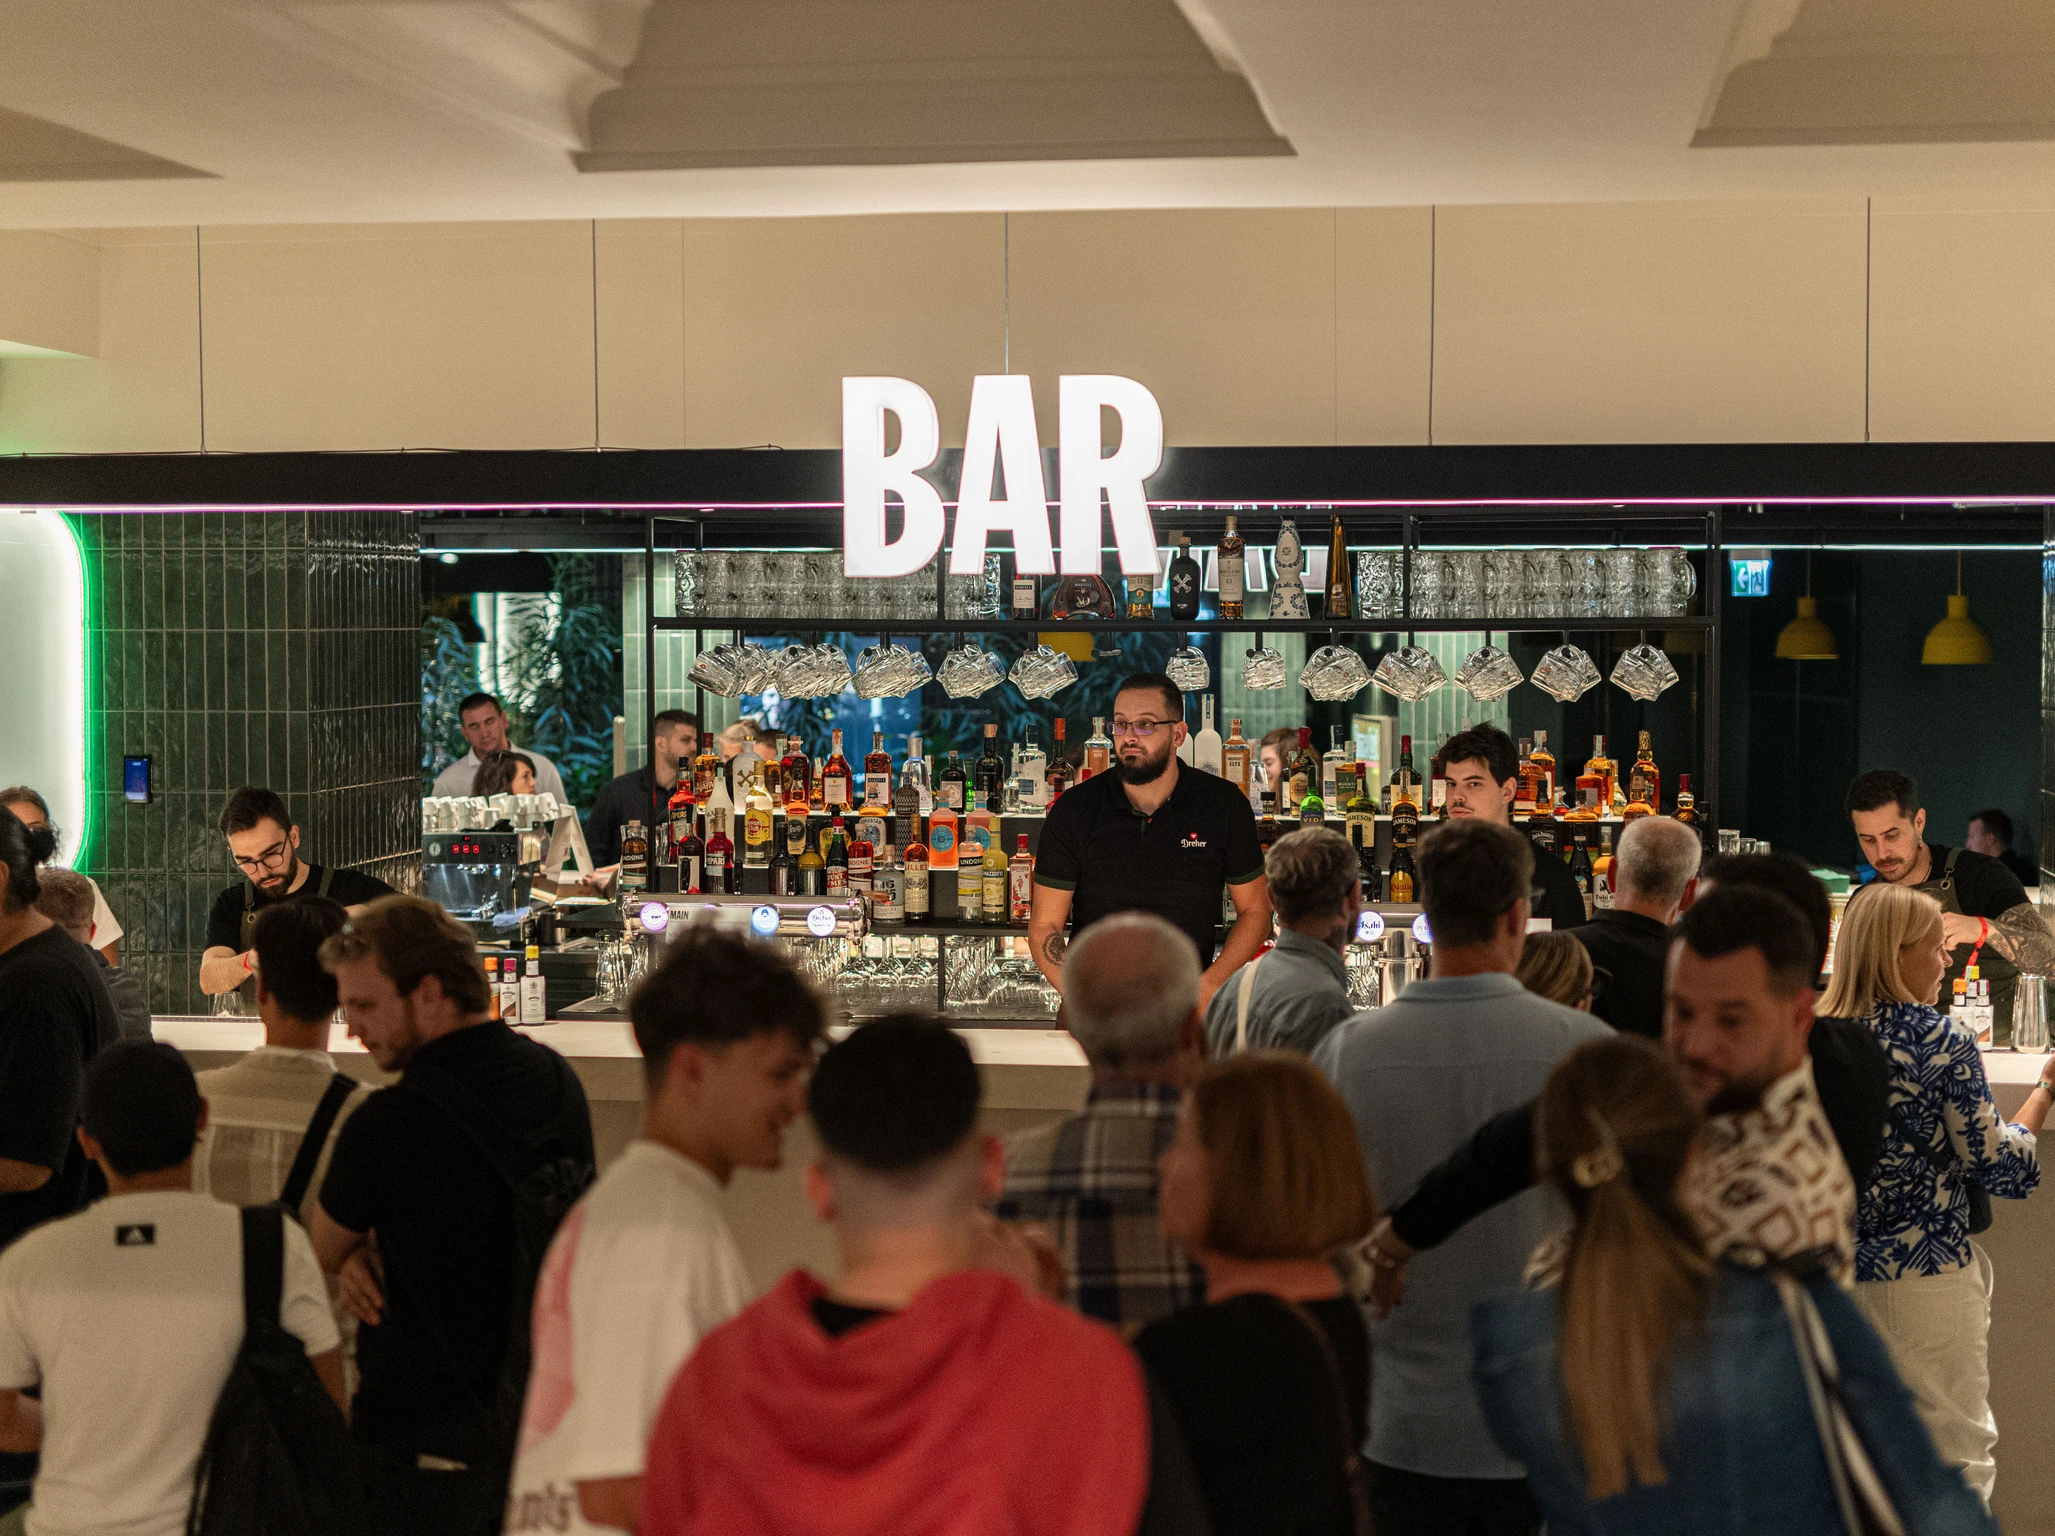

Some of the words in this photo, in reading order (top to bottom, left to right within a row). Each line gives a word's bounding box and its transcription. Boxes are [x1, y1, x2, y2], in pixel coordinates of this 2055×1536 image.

[842, 374, 1164, 577] BAR
[1393, 818, 1416, 826] JAMESON
[1181, 838, 1207, 848] Dreher
[832, 878, 848, 886] MES
[670, 911, 689, 920] MAIN
